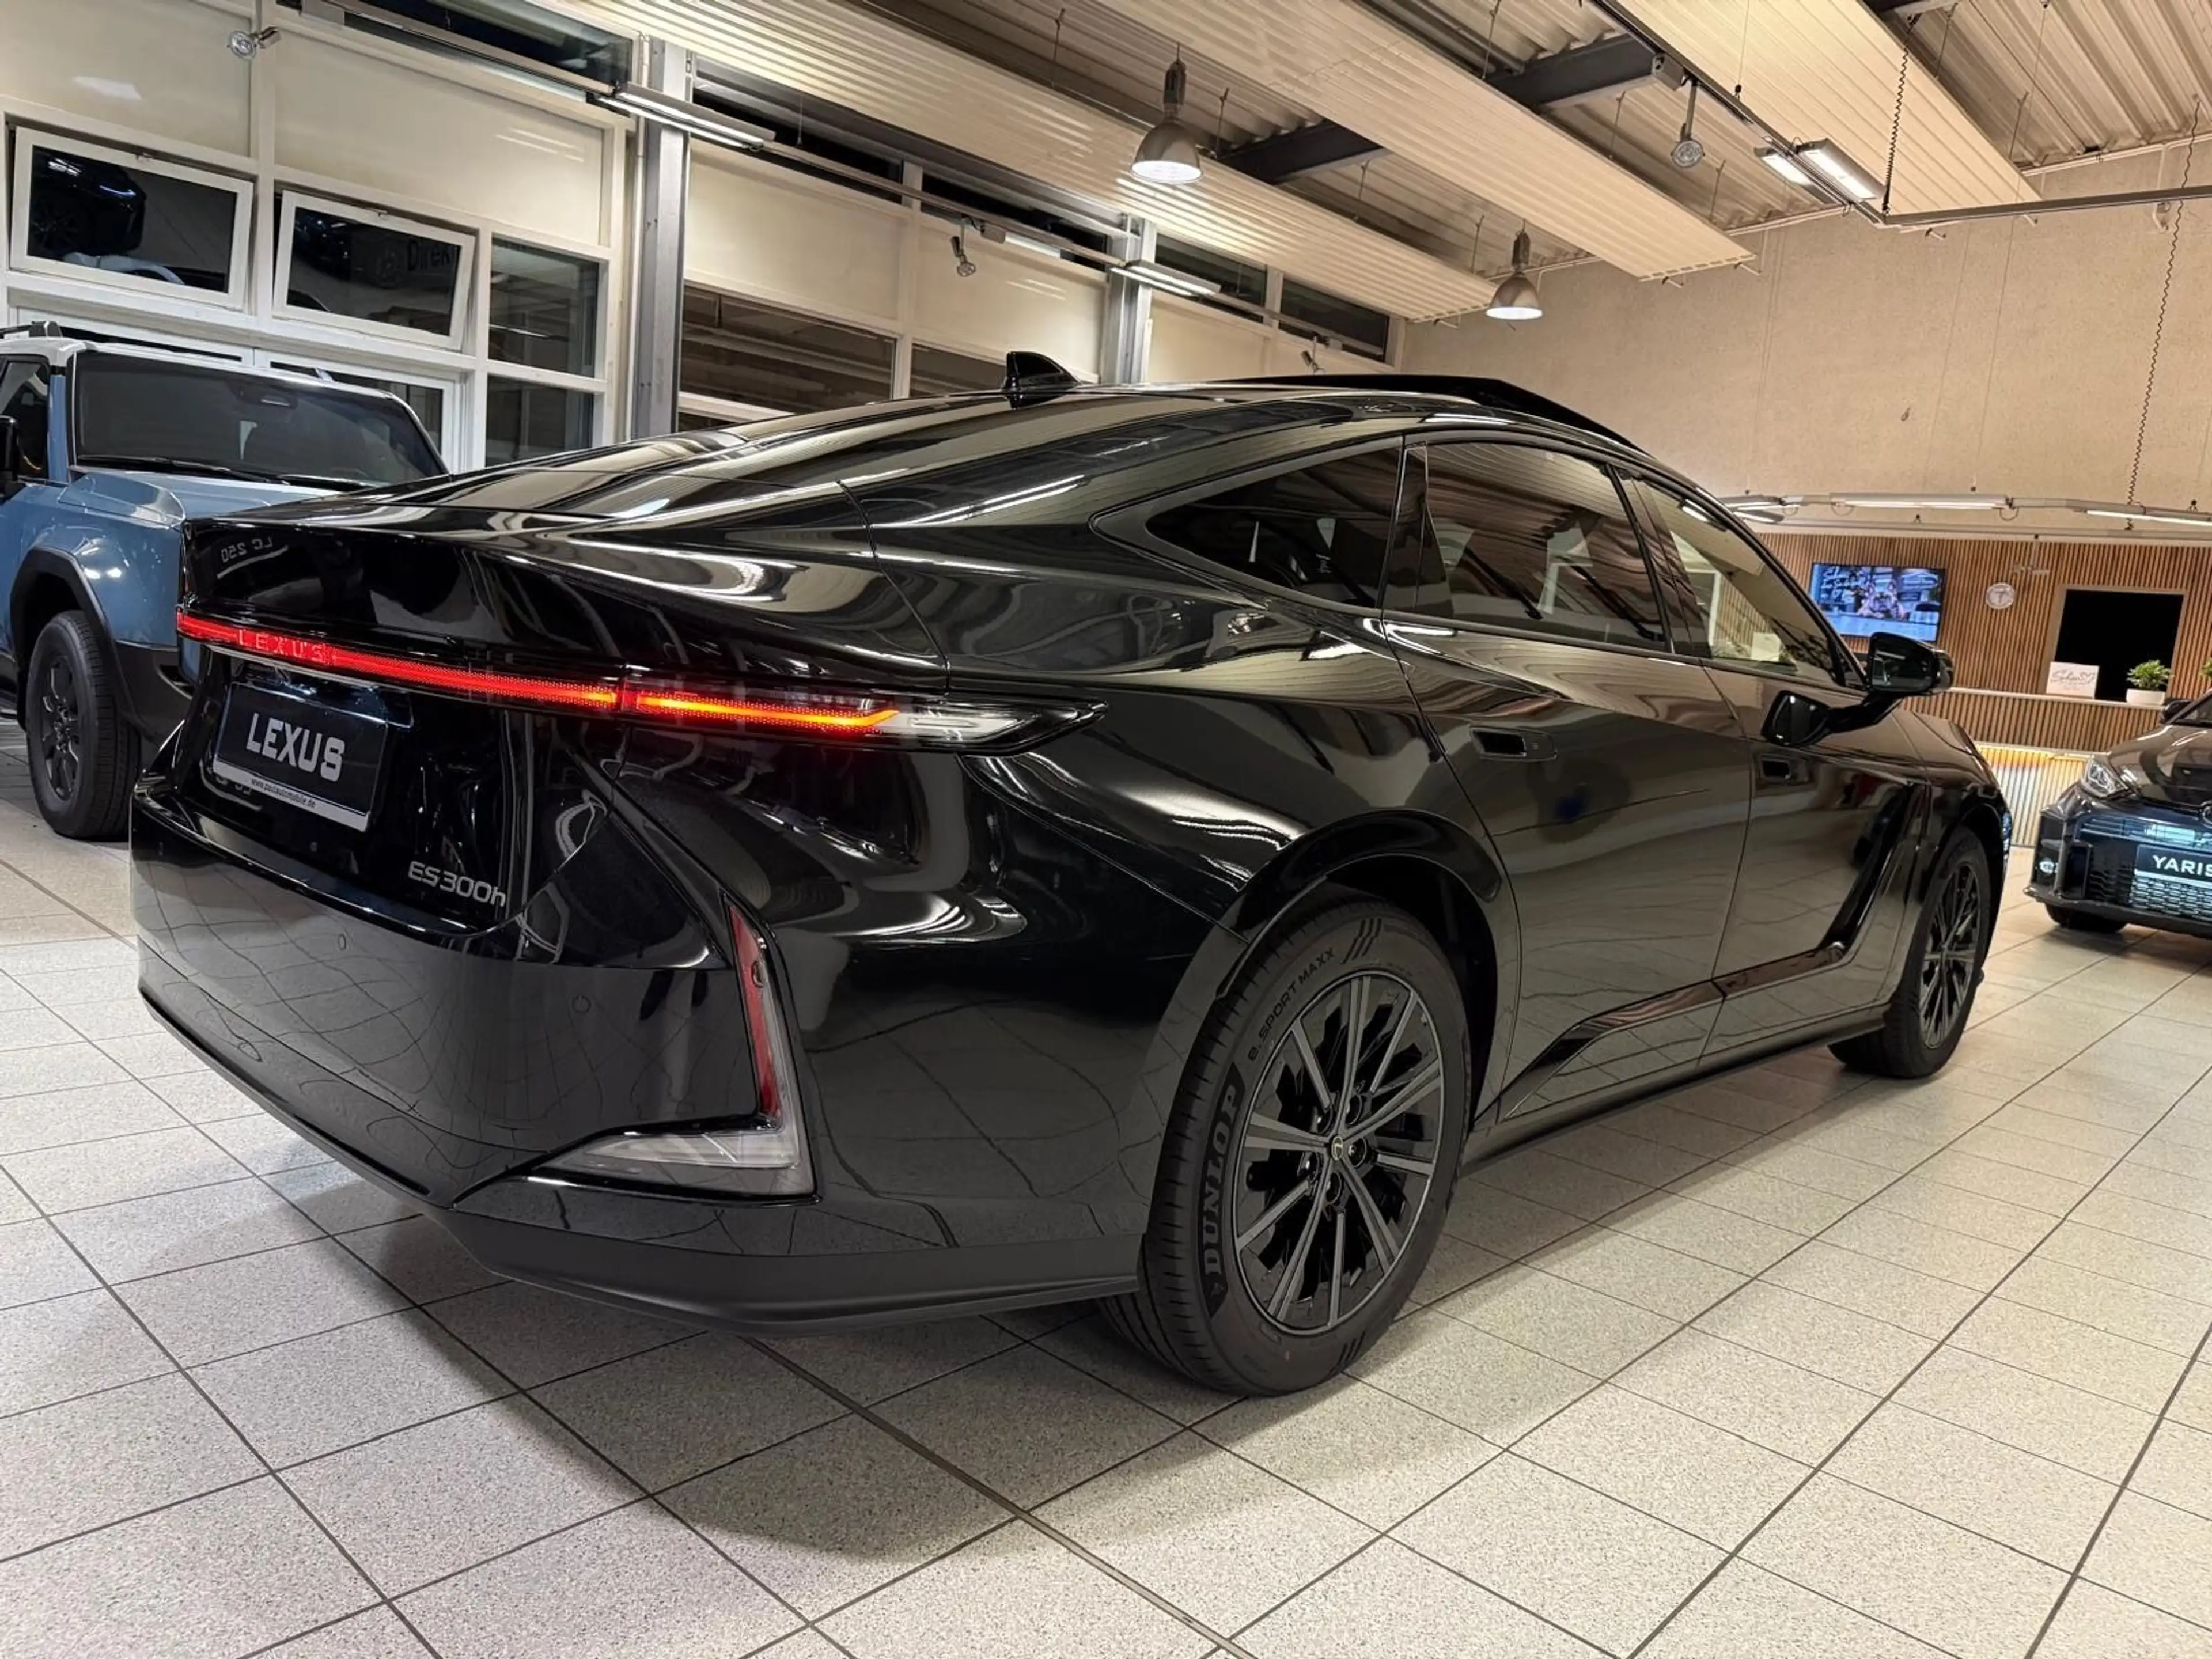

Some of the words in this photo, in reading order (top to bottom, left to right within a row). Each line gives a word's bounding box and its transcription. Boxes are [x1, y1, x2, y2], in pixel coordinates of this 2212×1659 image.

[239, 628, 327, 663] LEXUS
[246, 713, 345, 782] LEXUS
[408, 860, 506, 907] ES300h
[2152, 854, 2212, 877] YARIS
[1297, 947, 1335, 984] MAXX
[1202, 1084, 1237, 1275] DUNLOP
